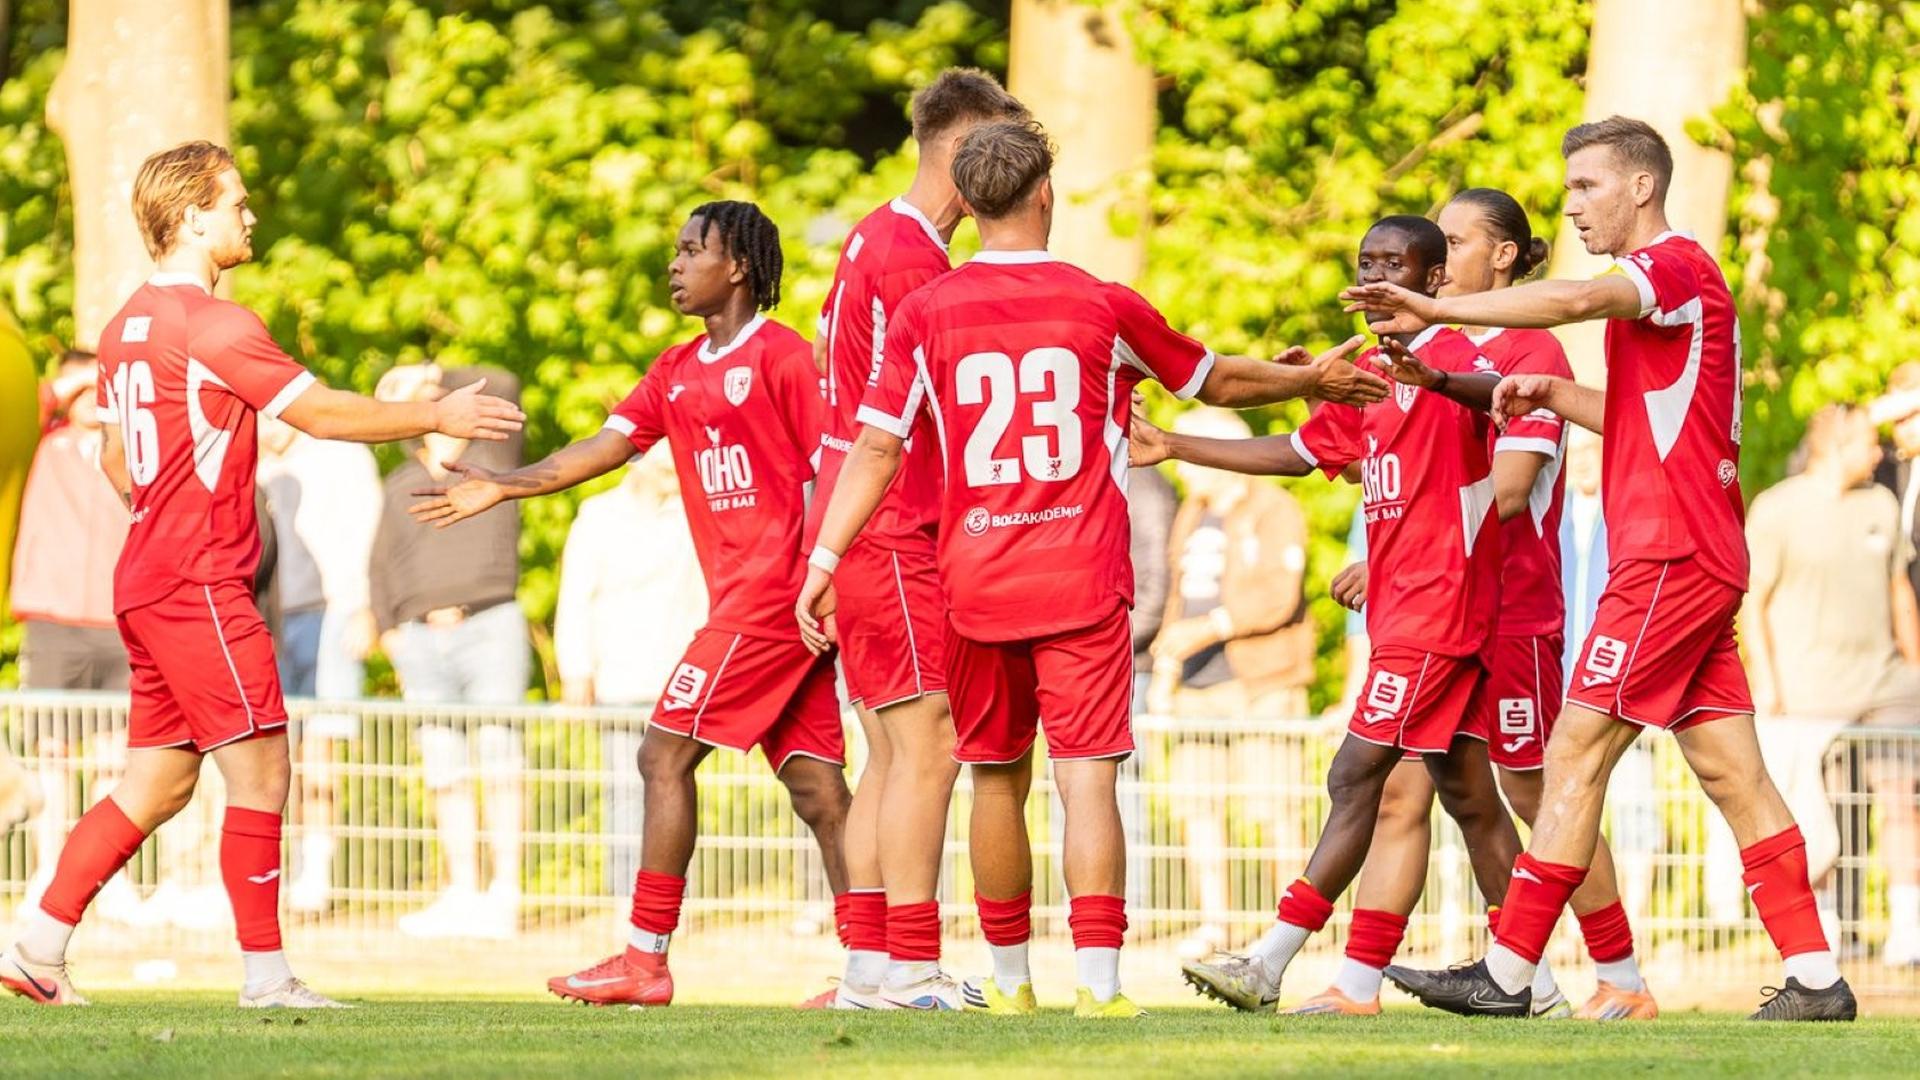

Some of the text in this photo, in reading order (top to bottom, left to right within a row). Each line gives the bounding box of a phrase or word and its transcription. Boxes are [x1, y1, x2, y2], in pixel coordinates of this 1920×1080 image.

[112, 360, 159, 486] 16
[955, 346, 1083, 487] 23
[992, 504, 1083, 527] BOLZAKADEMIE
